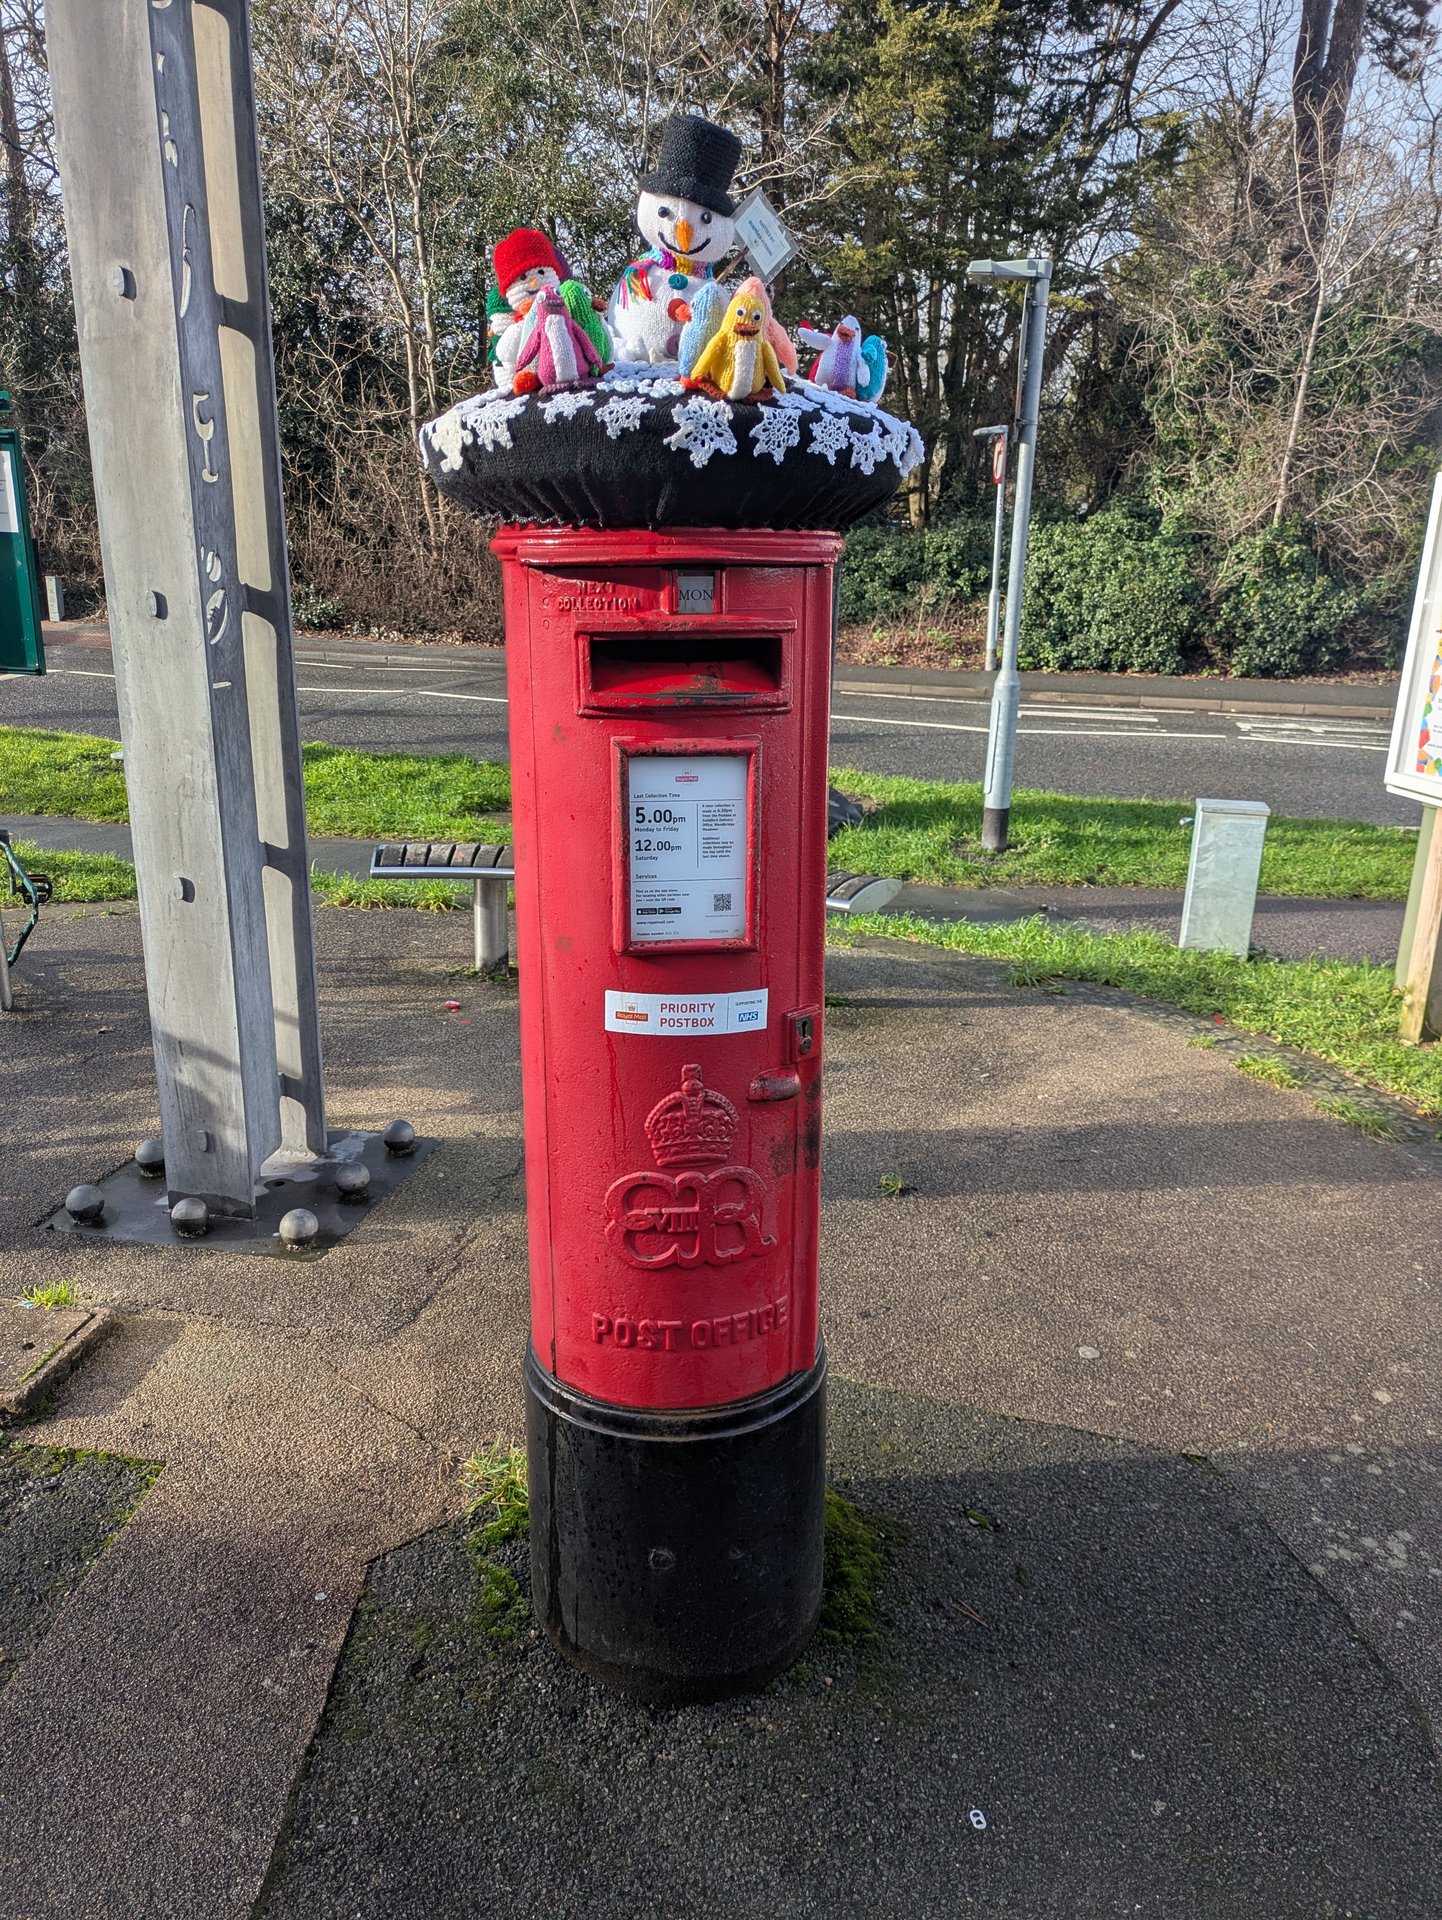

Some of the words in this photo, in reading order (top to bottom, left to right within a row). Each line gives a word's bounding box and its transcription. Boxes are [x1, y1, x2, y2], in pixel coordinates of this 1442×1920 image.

[577, 581, 616, 595] NEXT
[678, 589, 714, 601] MON
[558, 596, 641, 612] COLLECTION
[635, 807, 686, 824] 5.00pm
[635, 839, 682, 853] 12.00pm
[660, 1003, 715, 1014] PRIORITY
[660, 1017, 715, 1027] POSTBOX
[739, 1012, 758, 1021] NHS
[592, 1312, 682, 1350] POST
[690, 1295, 788, 1348] OFFICE
